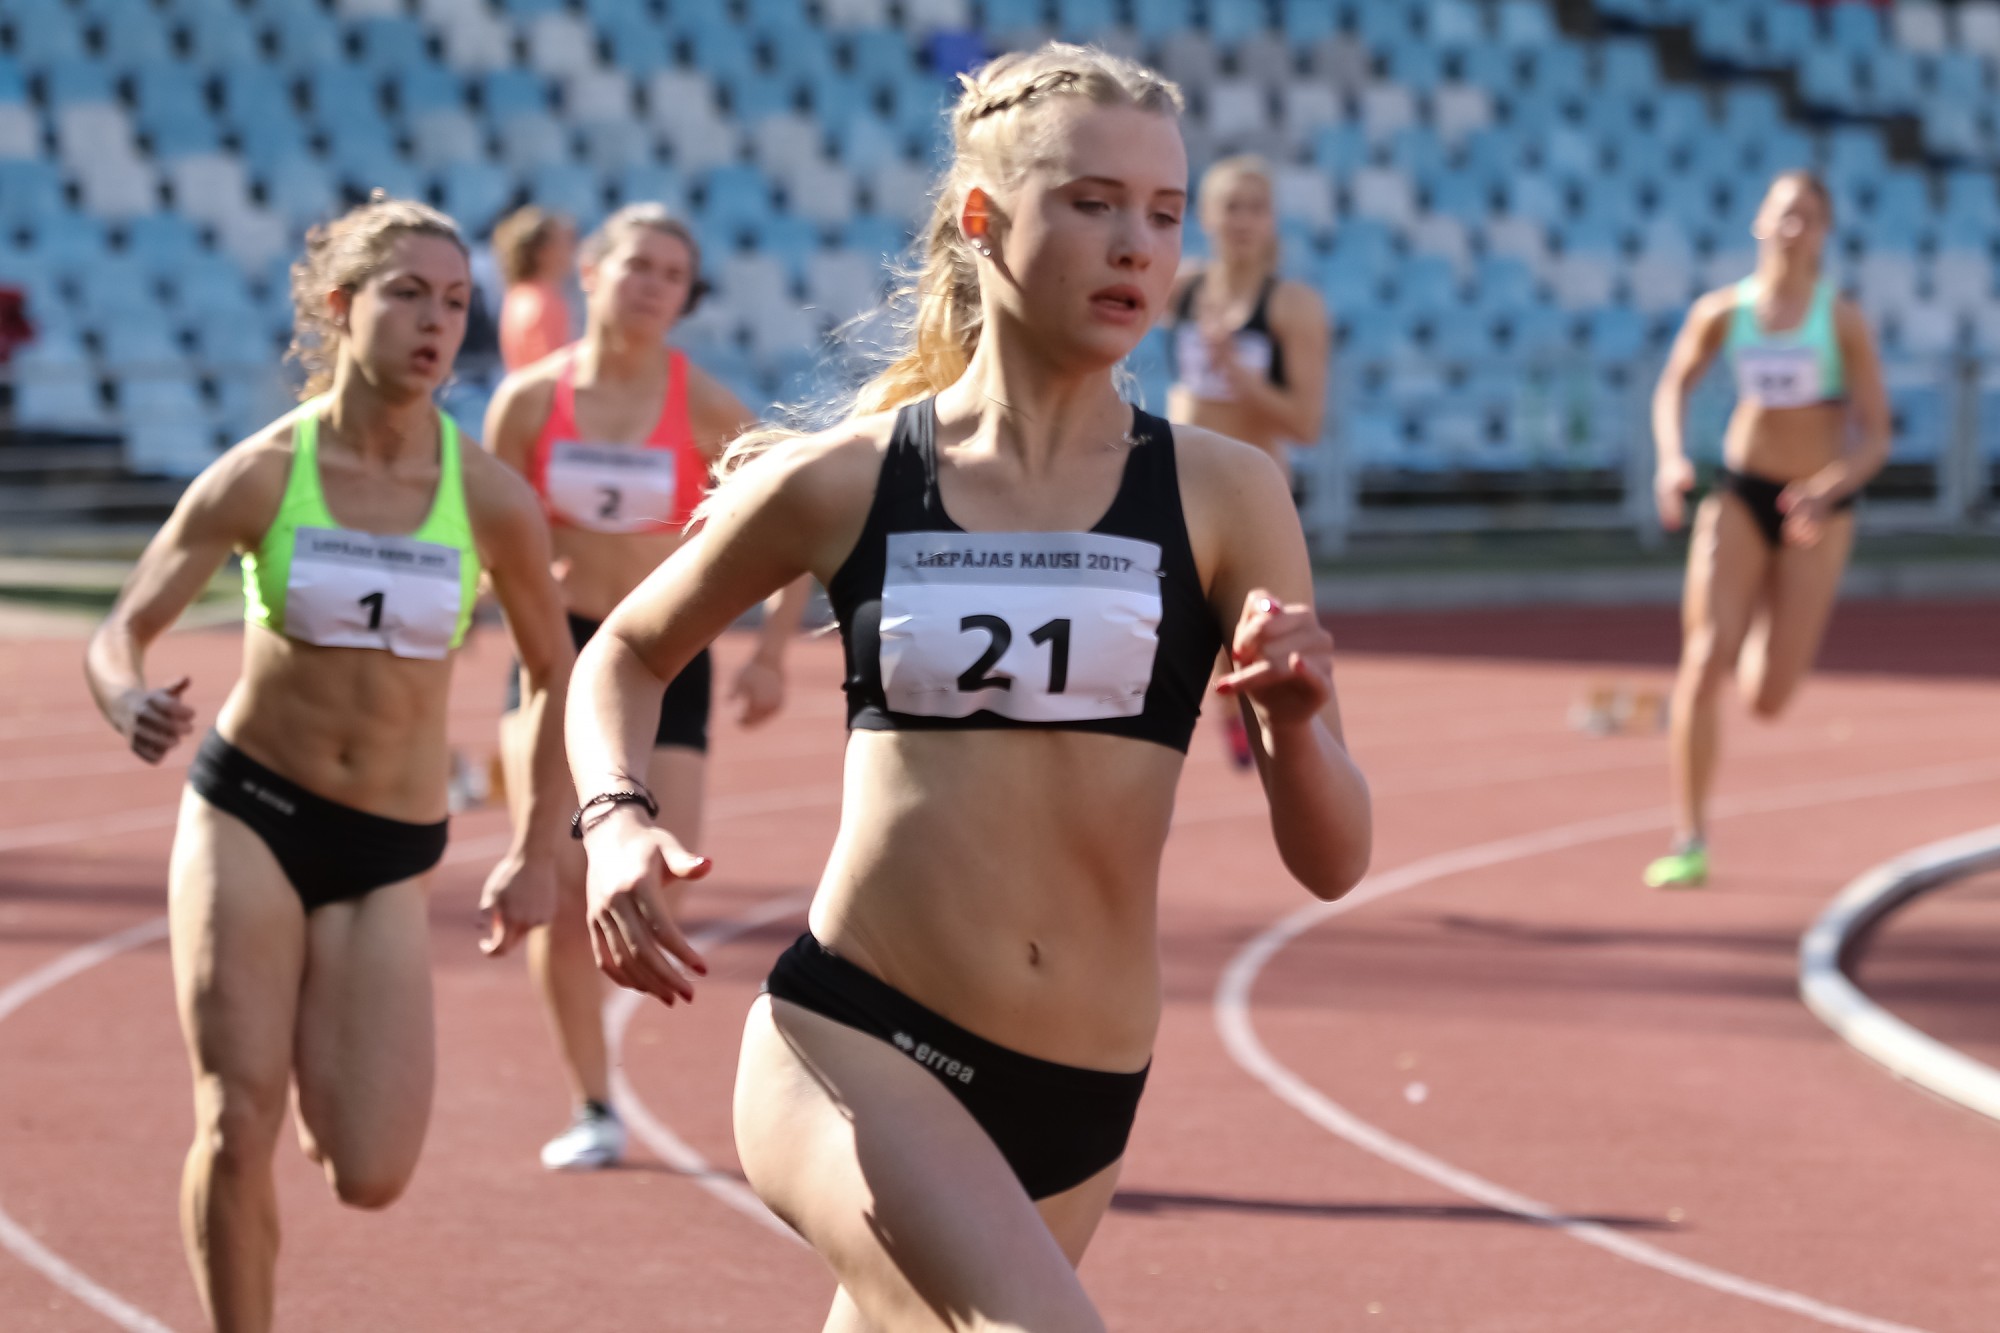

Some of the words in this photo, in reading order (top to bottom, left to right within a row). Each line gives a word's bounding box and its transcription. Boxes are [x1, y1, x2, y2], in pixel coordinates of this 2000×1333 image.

[596, 486, 622, 519] 2
[917, 549, 1013, 569] LIEPĀJAS
[1020, 552, 1080, 569] KAUSI
[1087, 553, 1133, 573] 2017
[359, 592, 384, 630] 1
[957, 614, 1070, 694] 21
[914, 1042, 974, 1084] errea
